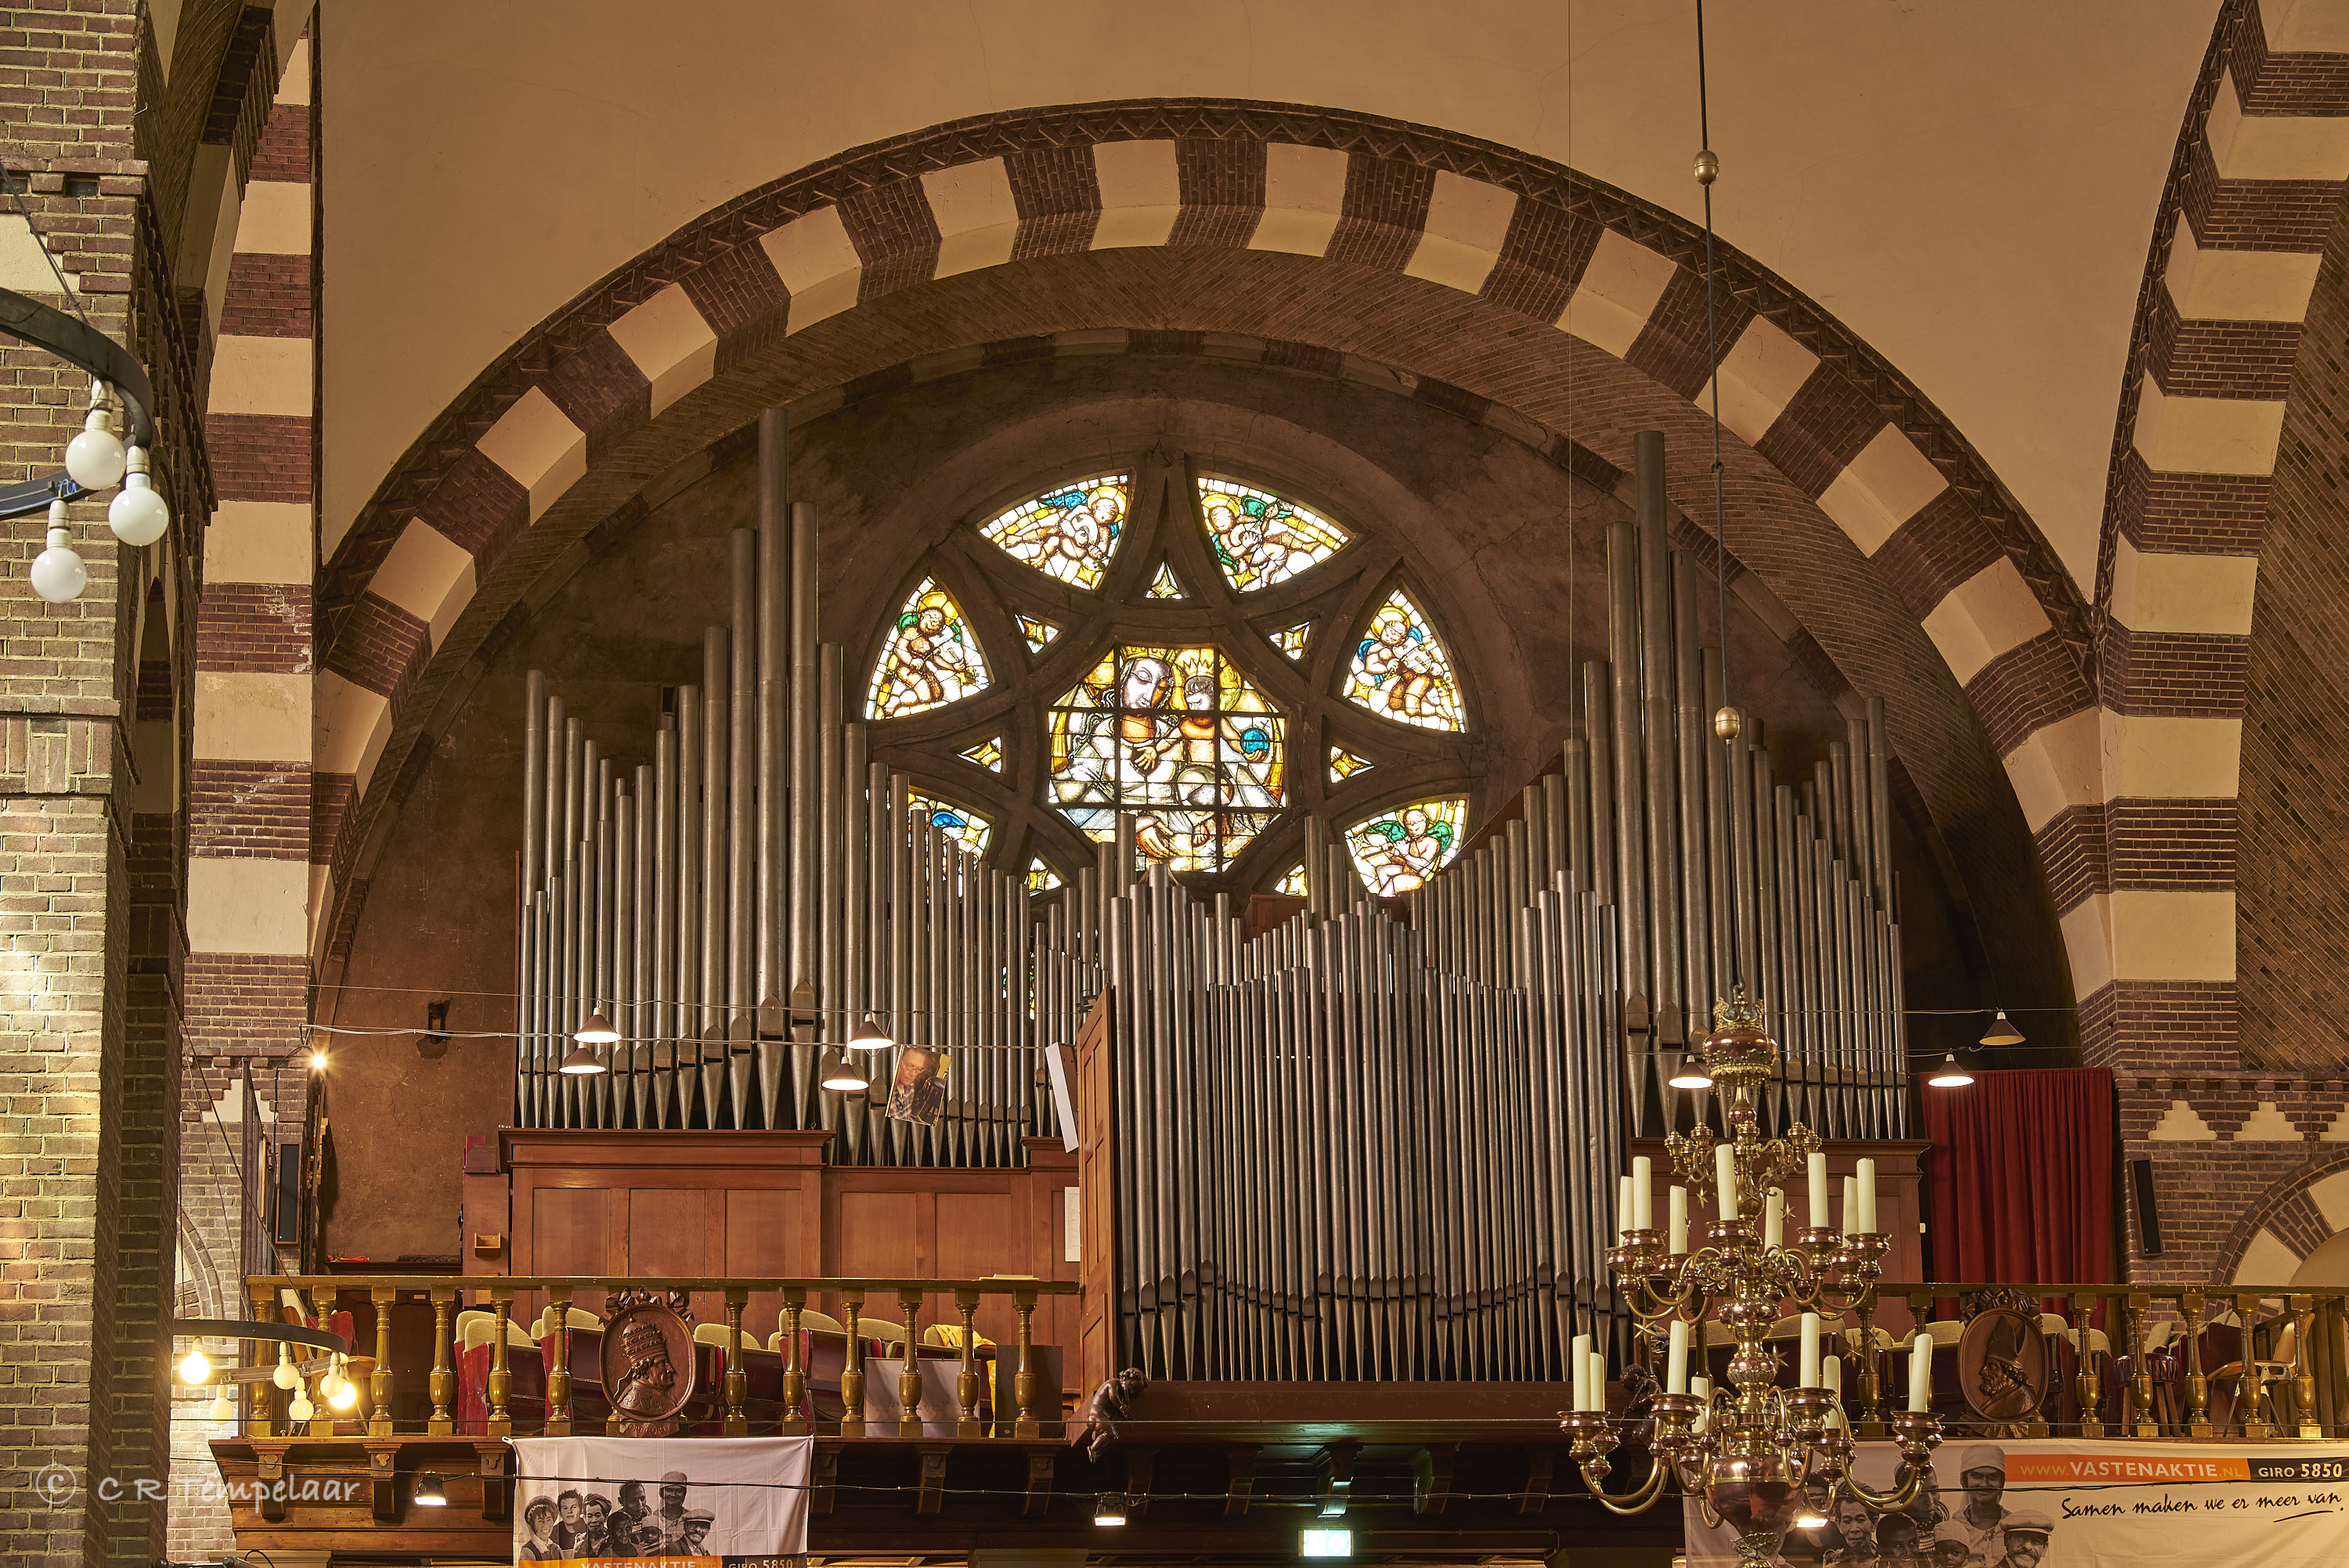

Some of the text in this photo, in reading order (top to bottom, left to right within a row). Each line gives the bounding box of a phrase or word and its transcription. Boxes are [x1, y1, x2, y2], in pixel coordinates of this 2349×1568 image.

[2257, 1466, 2296, 1478] GIRO
[2300, 1462, 2344, 1478] 5850
[2061, 1497, 2127, 1519] Samen
[2131, 1493, 2199, 1515] maken
[2203, 1498, 2225, 1511] we
[2231, 1498, 2250, 1510] er
[2255, 1495, 2301, 1509] meer
